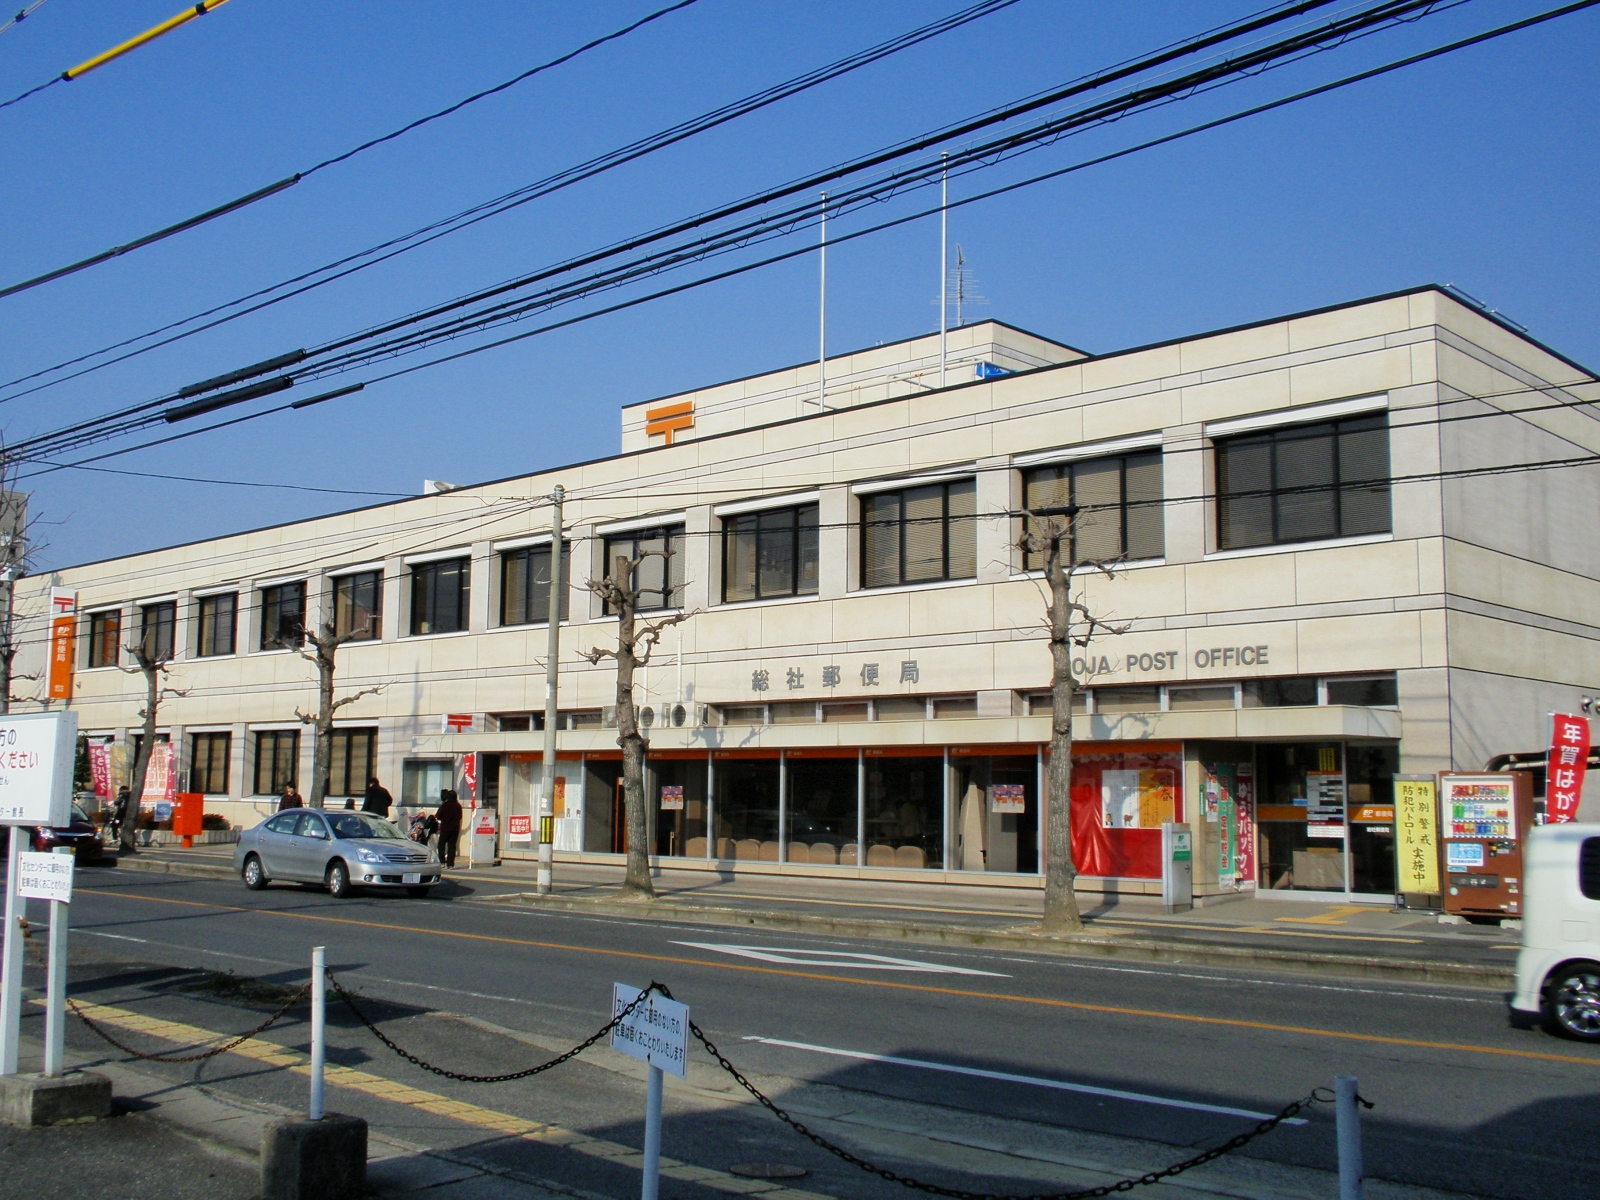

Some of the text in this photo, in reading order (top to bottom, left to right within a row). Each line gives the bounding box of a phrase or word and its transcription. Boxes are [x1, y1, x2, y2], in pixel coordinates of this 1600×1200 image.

[56, 637, 67, 662] 郵便局
[1072, 645, 1269, 675] OJA POST OFFICE
[751, 660, 920, 692] 総社郵便局
[1238, 783, 1248, 875] ゆうパック。
[1403, 785, 1415, 844] 防犯パトロール
[1418, 786, 1432, 846] 特別警戒
[1412, 847, 1426, 885] 実施中
